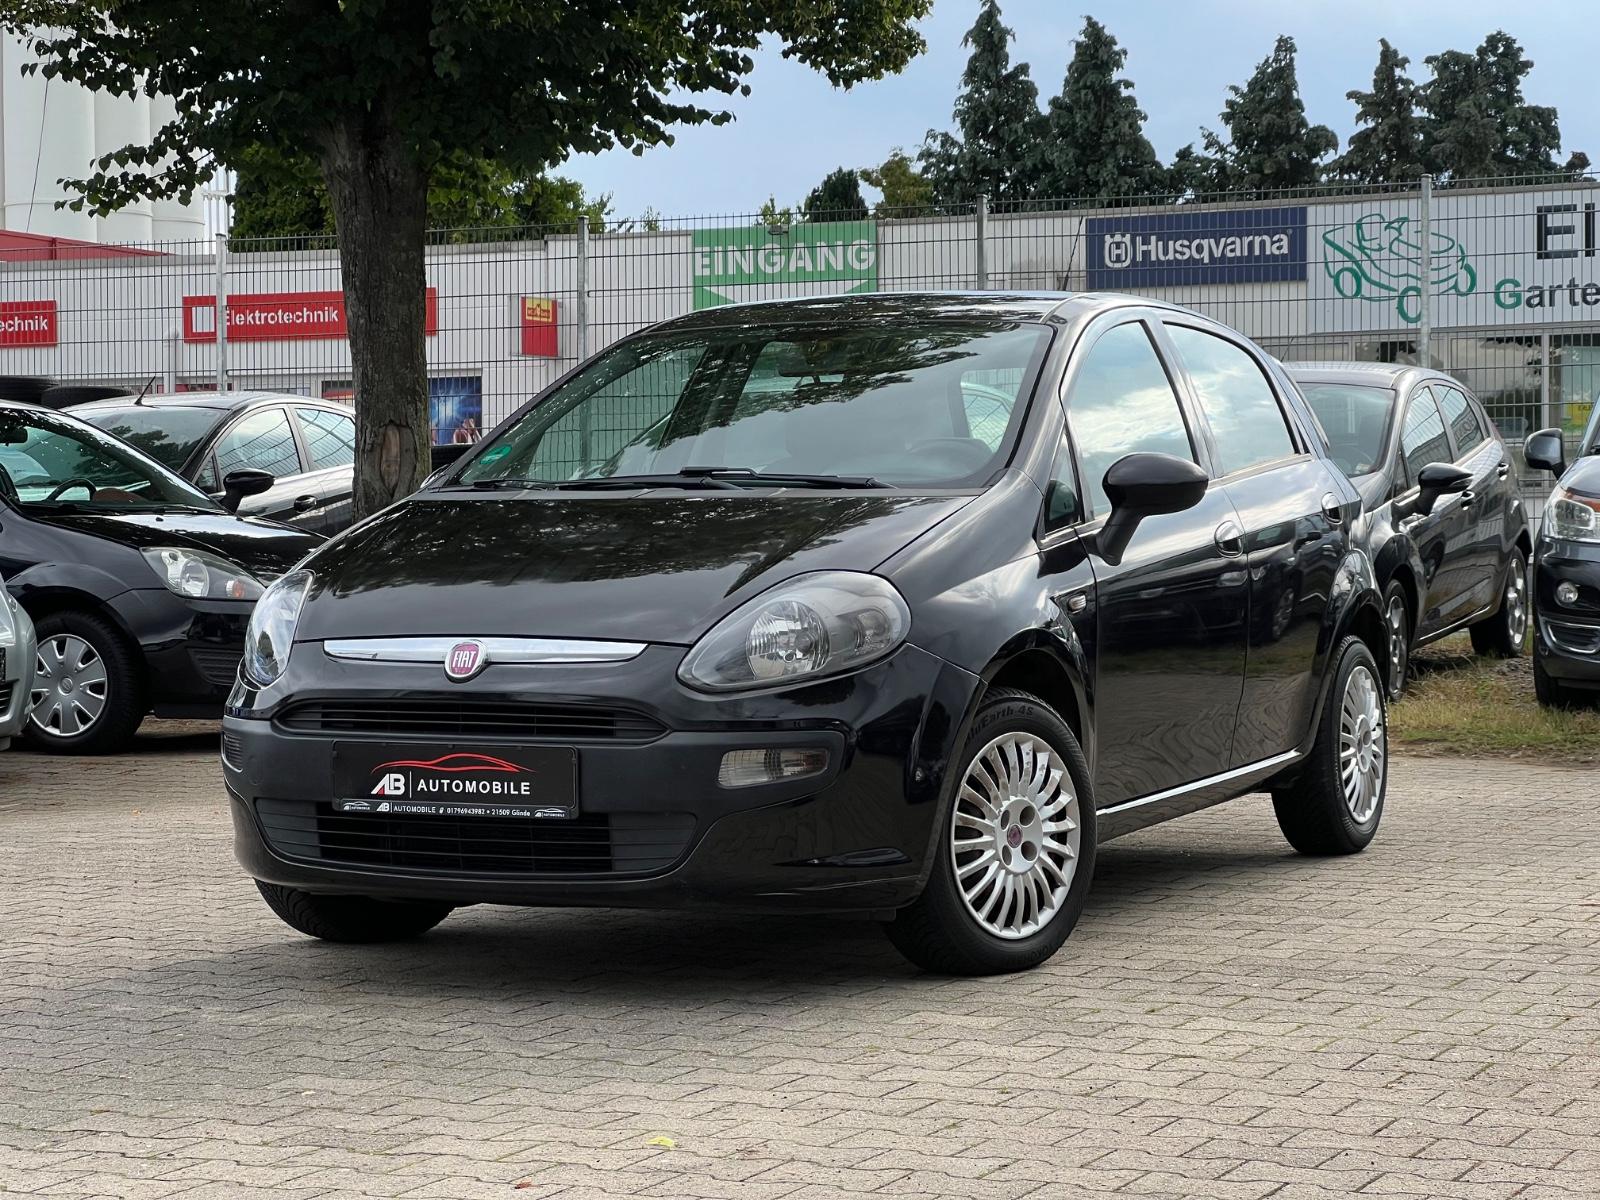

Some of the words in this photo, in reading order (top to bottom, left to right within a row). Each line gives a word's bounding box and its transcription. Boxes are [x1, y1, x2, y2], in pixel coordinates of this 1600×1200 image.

[695, 239, 876, 276] EINGANG
[1136, 233, 1289, 264] Husqvarna
[1494, 277, 1600, 310] Garte
[452, 650, 477, 668] FIAT
[370, 773, 406, 796] AB
[417, 778, 531, 795] AUTOMOBILE
[393, 805, 436, 813] AUTOMOBILE
